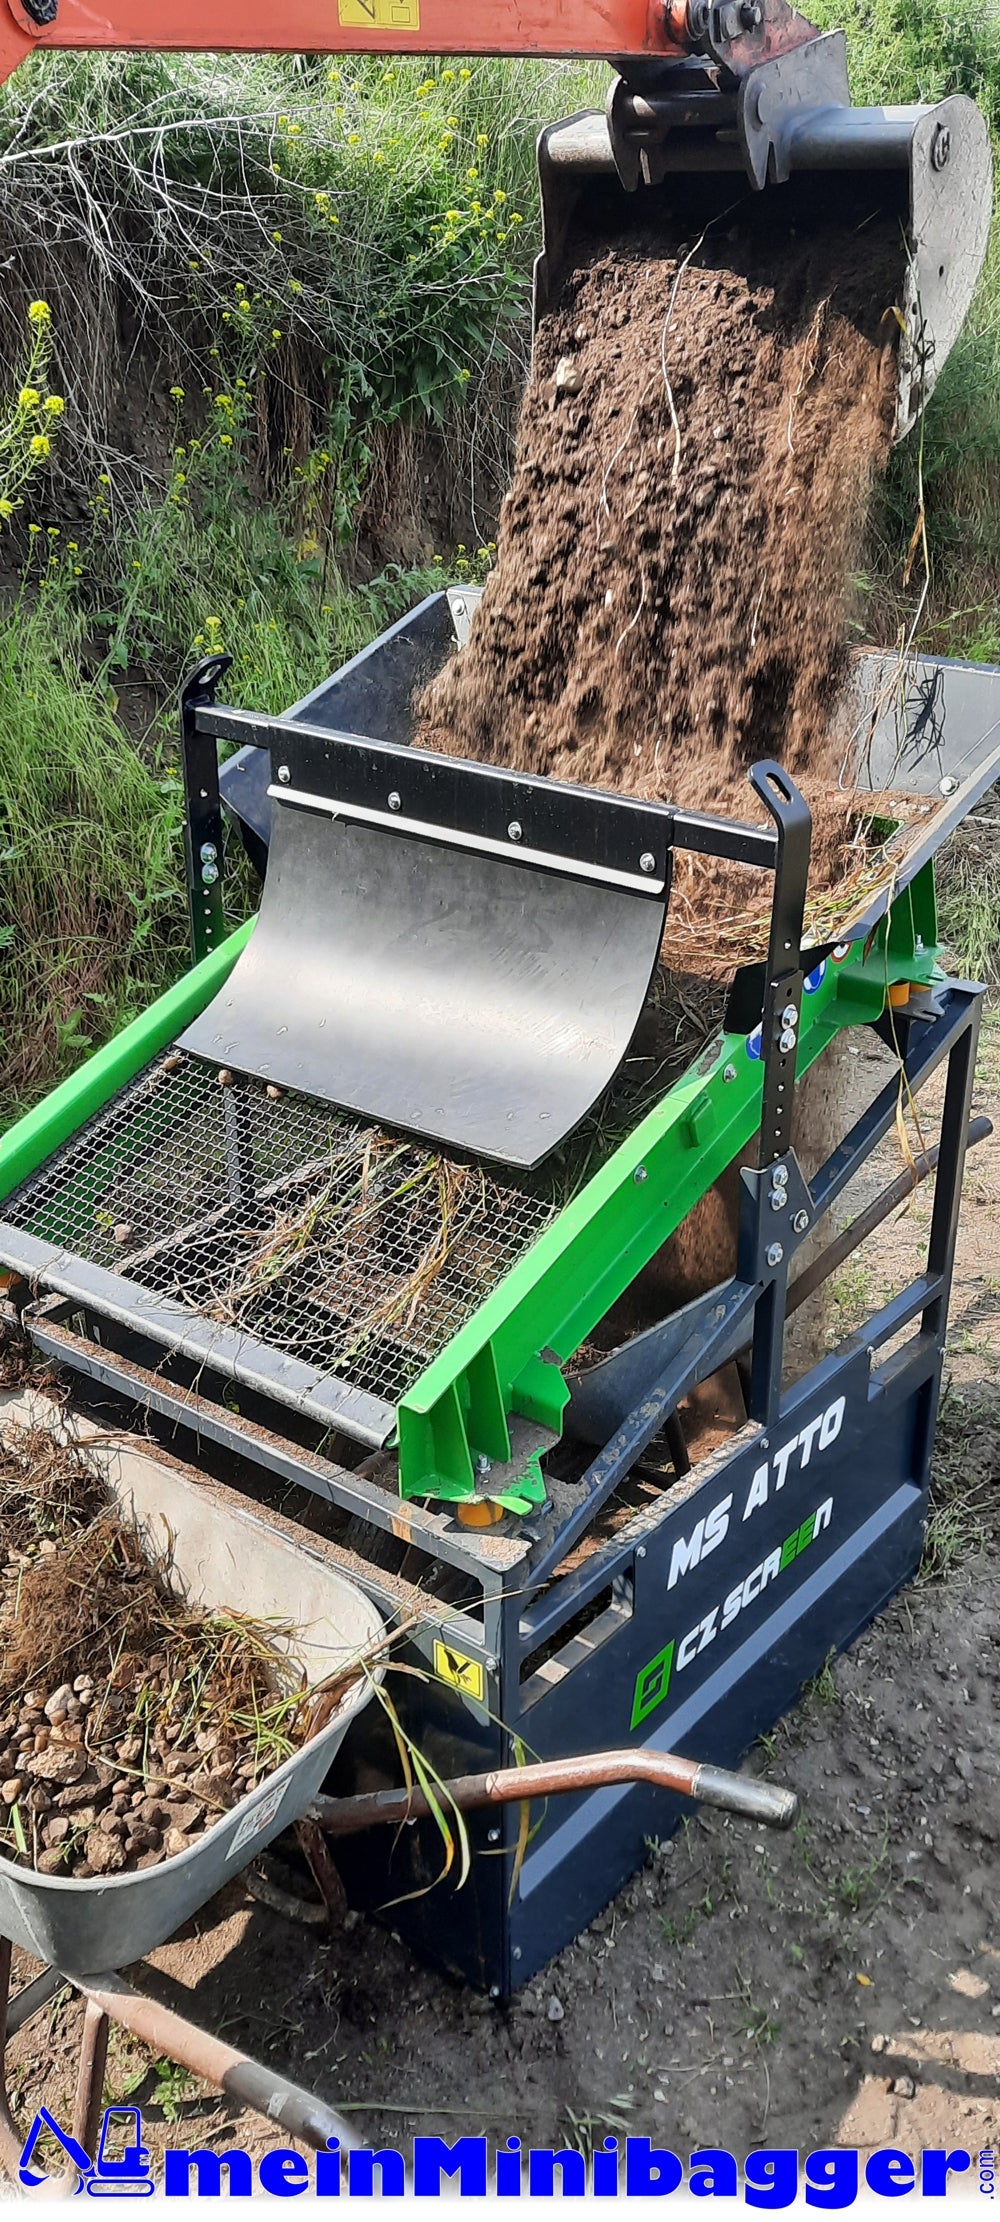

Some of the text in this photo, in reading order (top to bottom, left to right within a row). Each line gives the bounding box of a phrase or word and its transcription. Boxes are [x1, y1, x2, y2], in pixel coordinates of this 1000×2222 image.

[667, 1396, 846, 1591] MS ATTO
[676, 1605, 720, 1672] CZ
